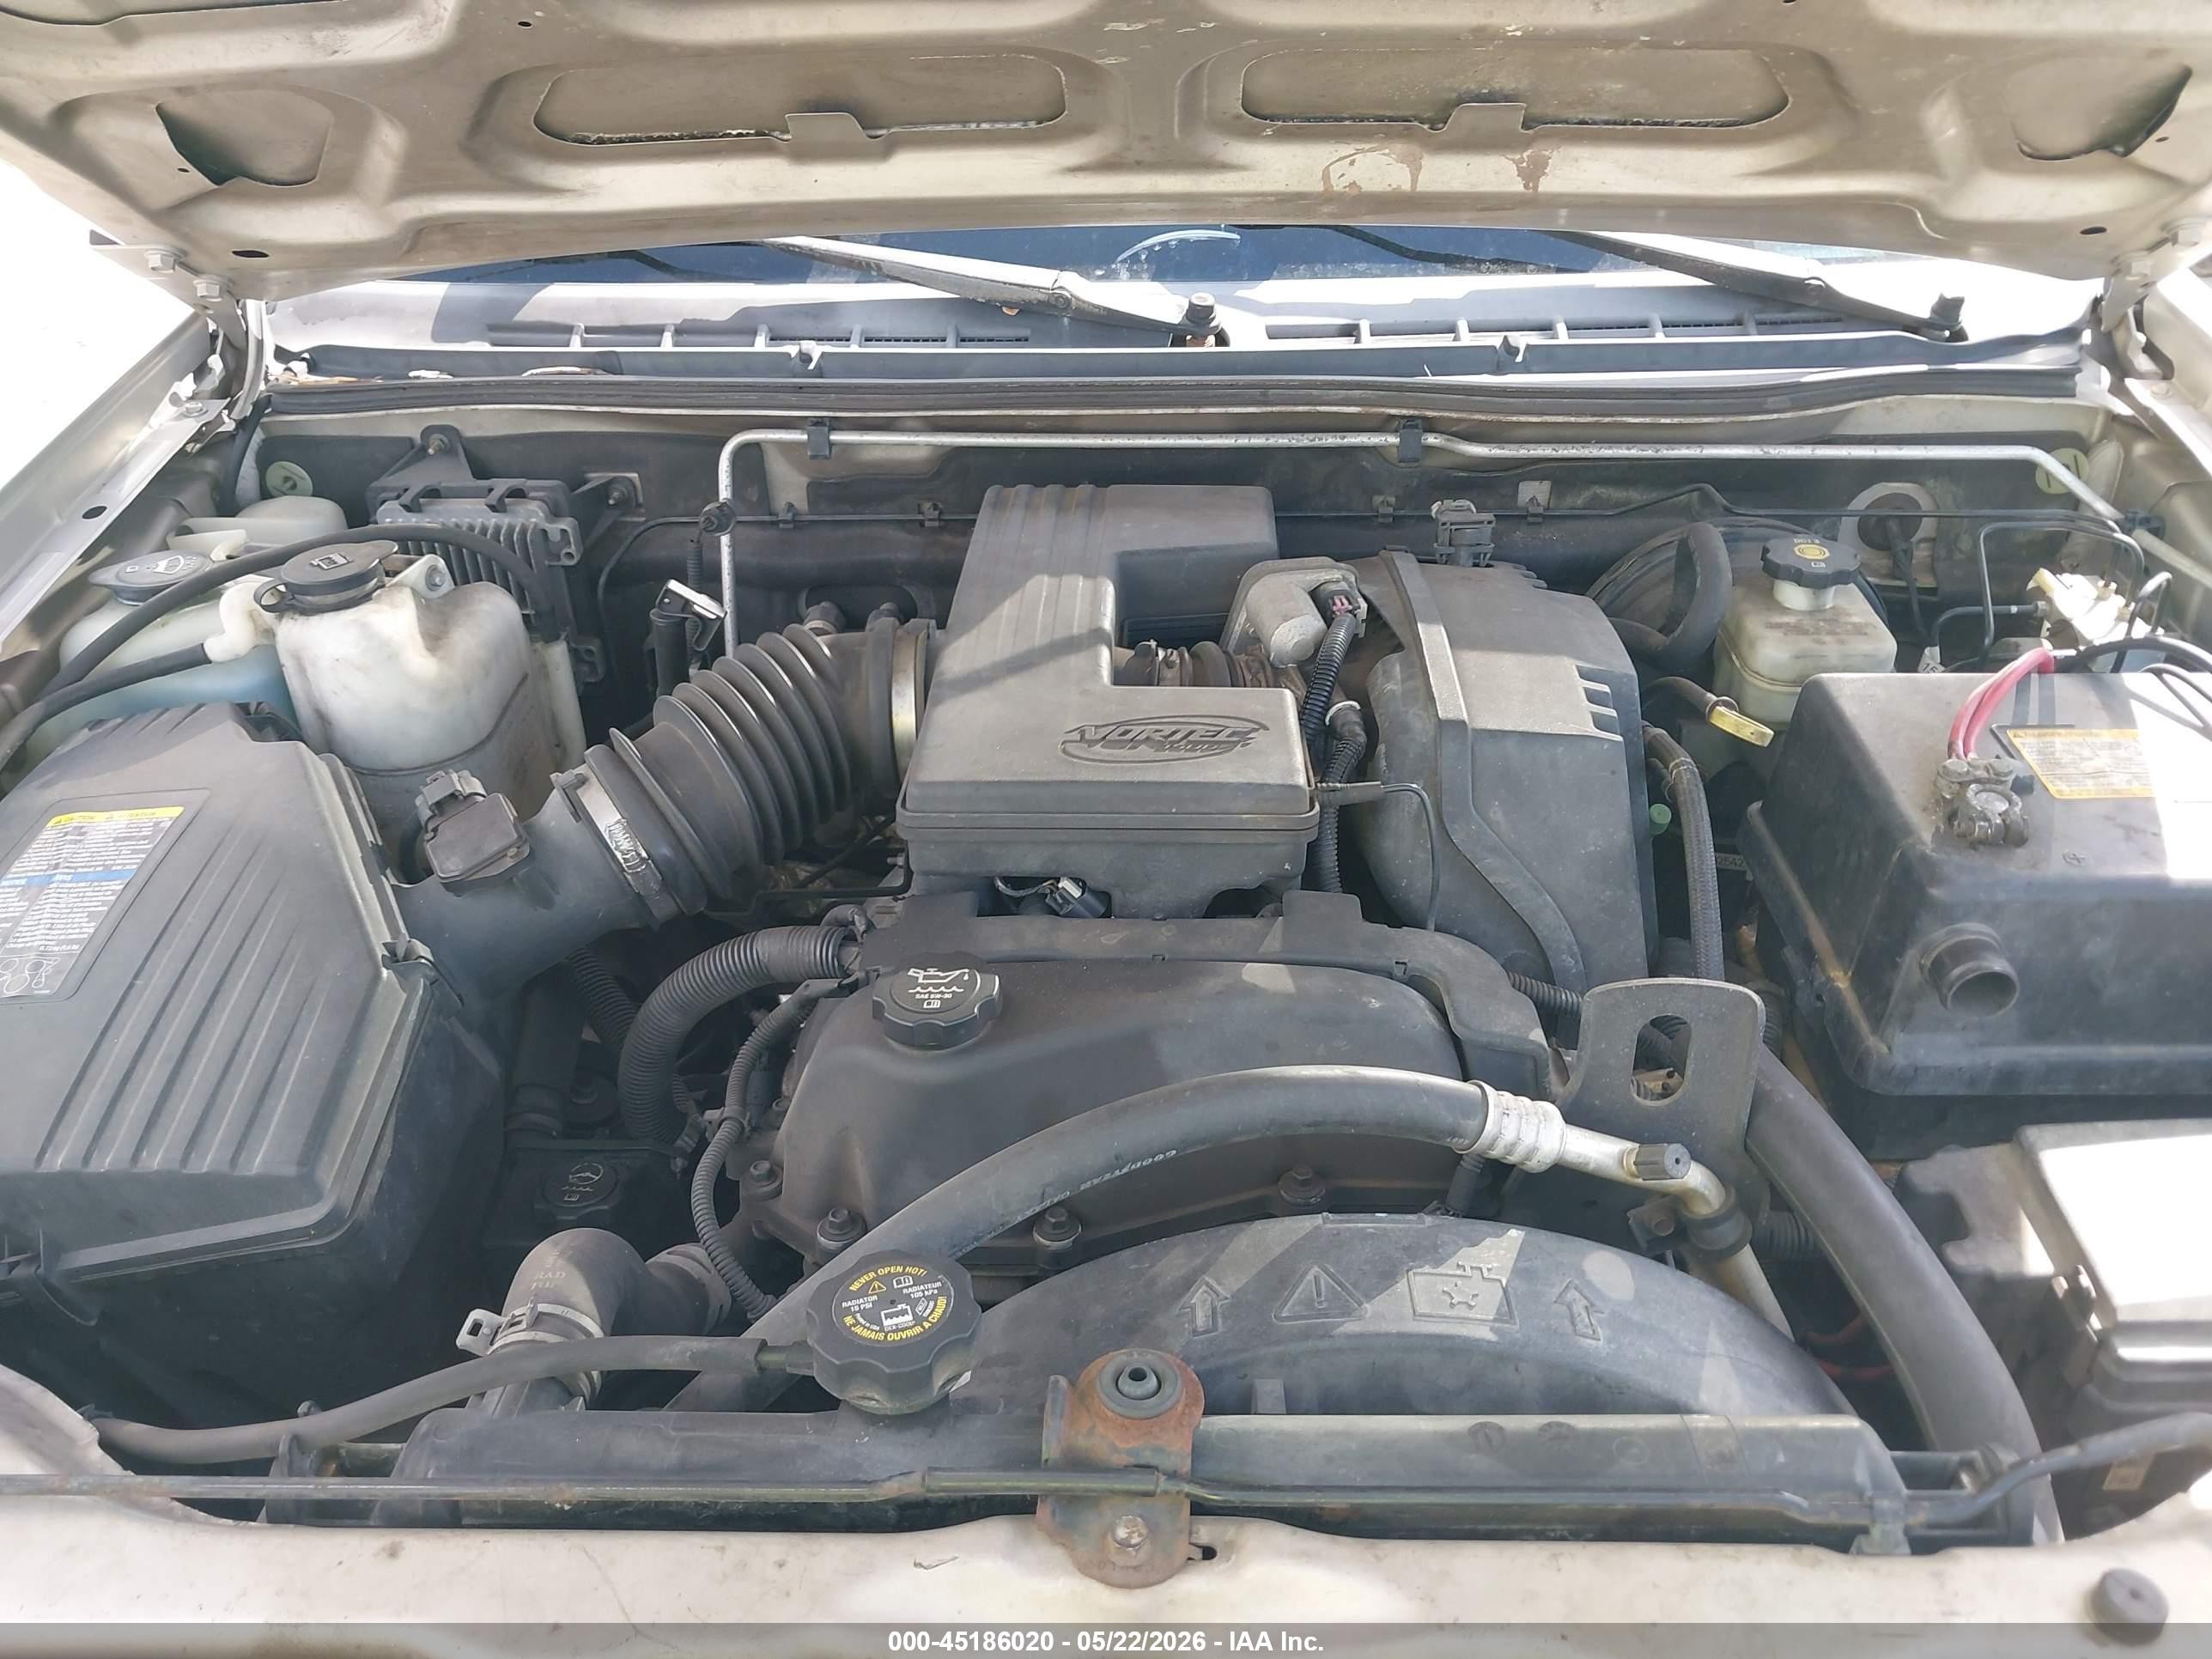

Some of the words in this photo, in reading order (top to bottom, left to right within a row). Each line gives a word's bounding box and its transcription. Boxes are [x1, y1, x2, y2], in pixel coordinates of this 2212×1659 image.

[848, 1271, 877, 1291] NEVER
[878, 1265, 903, 1277] OPEN
[905, 1265, 927, 1277] HOT!
[902, 1281, 943, 1294] RADIATEUR
[842, 1295, 878, 1308] RADIATOR
[860, 1302, 873, 1310] PSI
[843, 1315, 856, 1327] NE
[851, 1324, 885, 1340] JAMAIS
[887, 1325, 925, 1340] OUVRIR
[928, 1296, 948, 1323] CHAUD!
